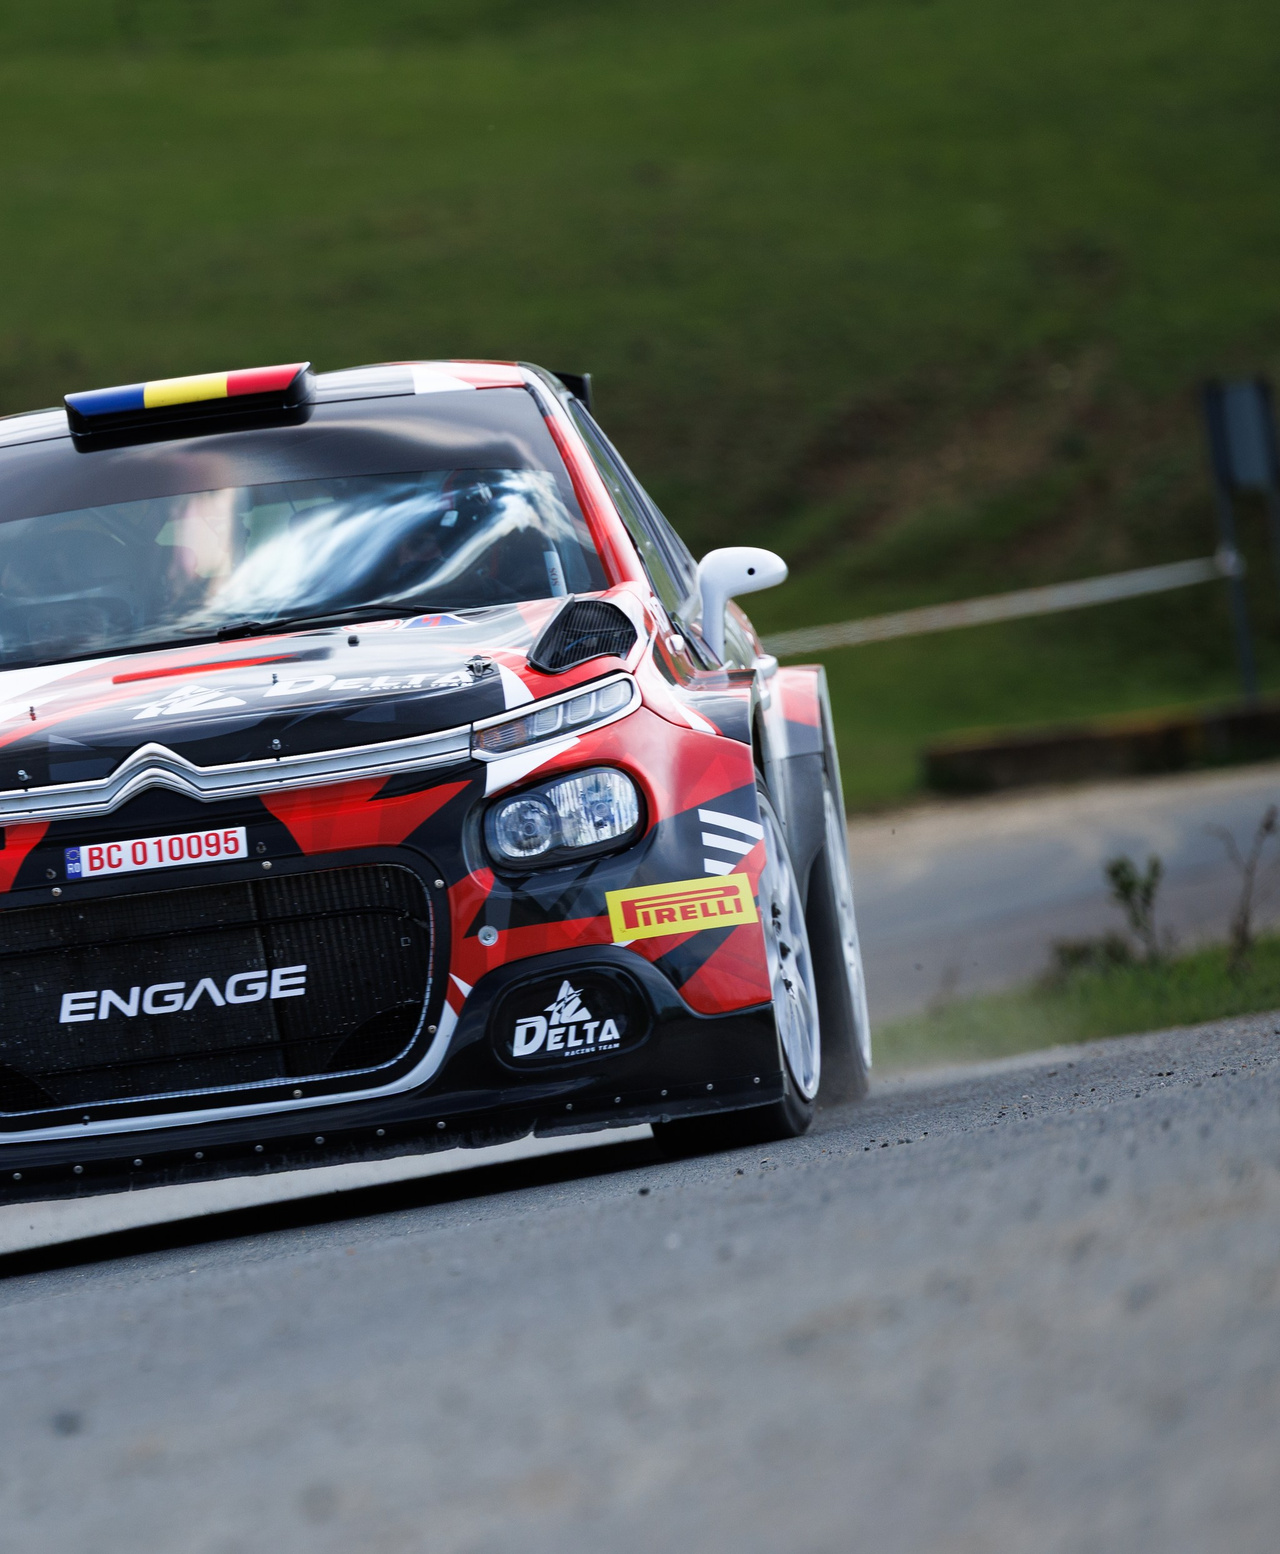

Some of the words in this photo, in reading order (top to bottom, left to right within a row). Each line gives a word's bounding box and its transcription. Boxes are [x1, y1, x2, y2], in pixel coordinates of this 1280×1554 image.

[263, 670, 475, 698] DELTA
[67, 862, 81, 874] RO
[88, 844, 123, 871] BC
[131, 830, 240, 866] 010095
[620, 885, 744, 930] PIRELLI
[59, 964, 307, 1024] ENGAGE
[513, 1015, 621, 1057] DELTA
[564, 1046, 596, 1057] RACING
[598, 1042, 620, 1051] TEAM
